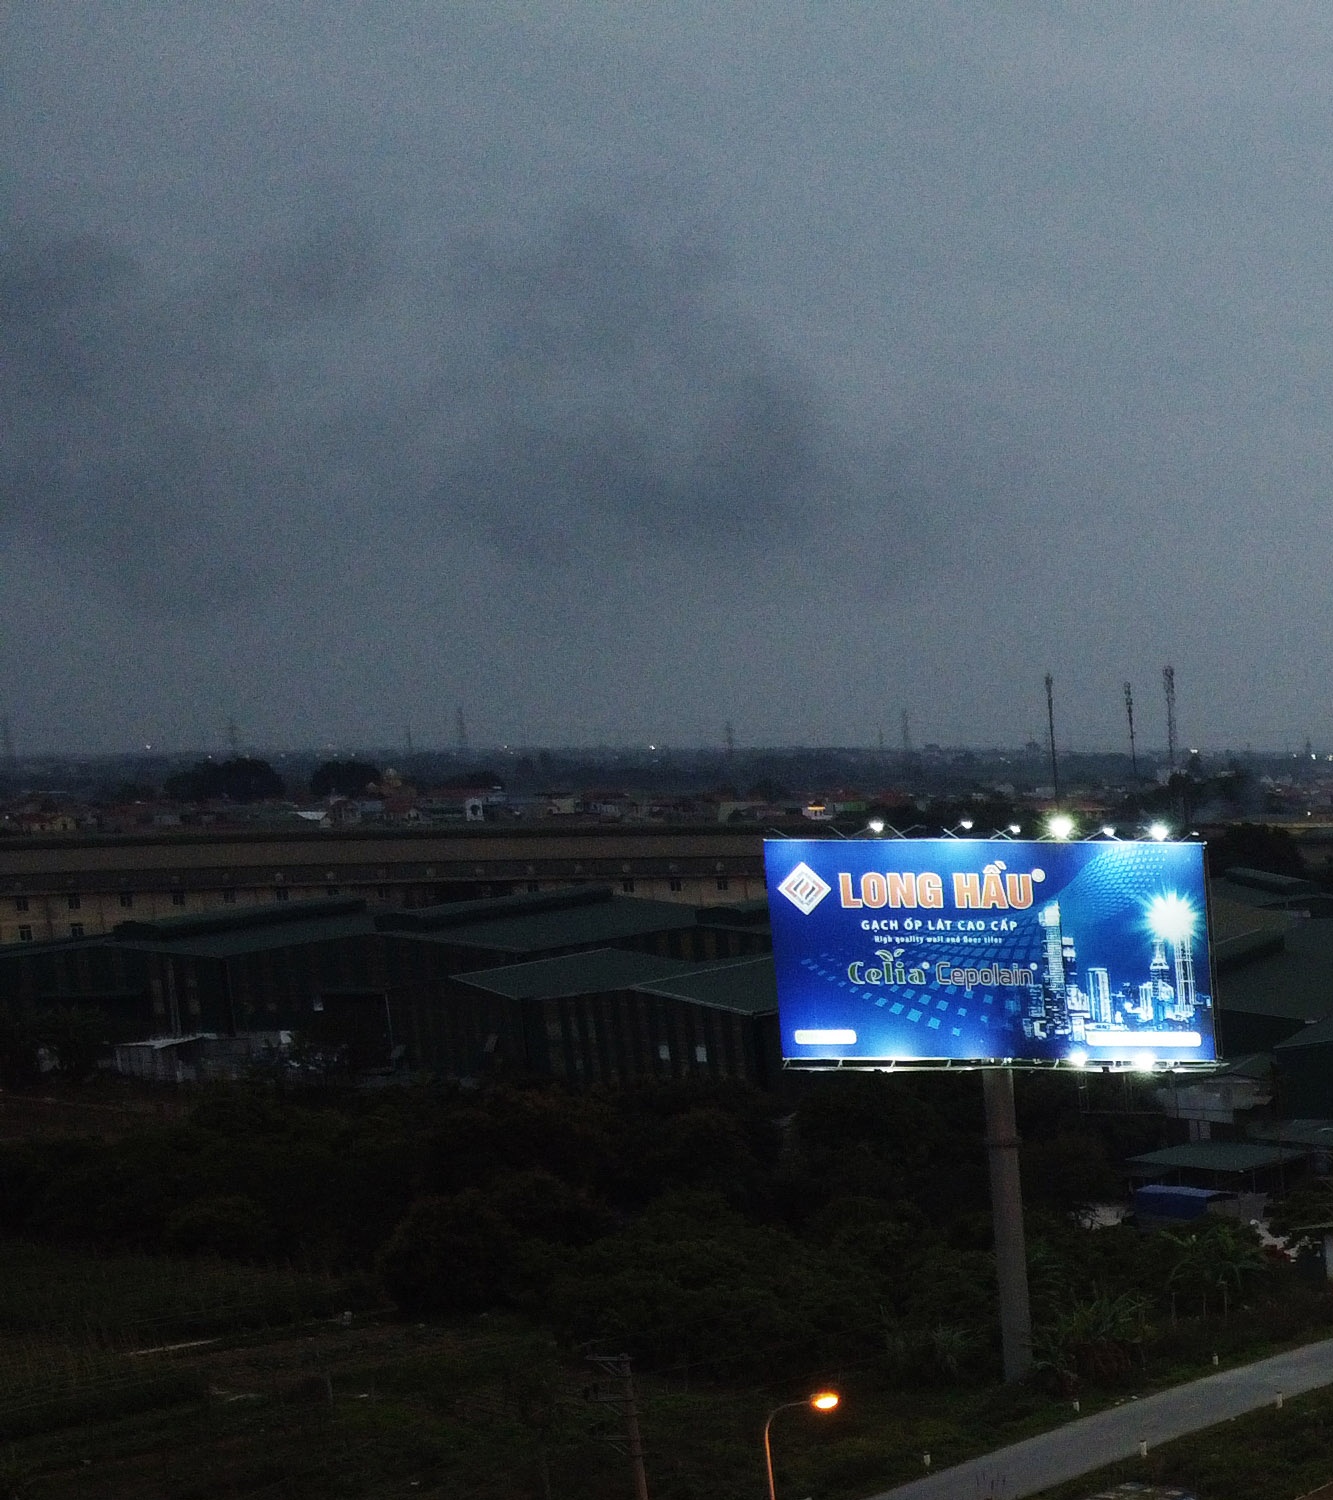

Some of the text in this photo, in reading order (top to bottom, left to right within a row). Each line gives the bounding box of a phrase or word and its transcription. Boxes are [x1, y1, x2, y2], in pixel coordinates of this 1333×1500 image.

[838, 861, 1033, 909] LONG HẦU
[861, 917, 1018, 933] GẠCH ỐP LÁT CAO CẤP
[848, 959, 1034, 991] Celia Cepolain
